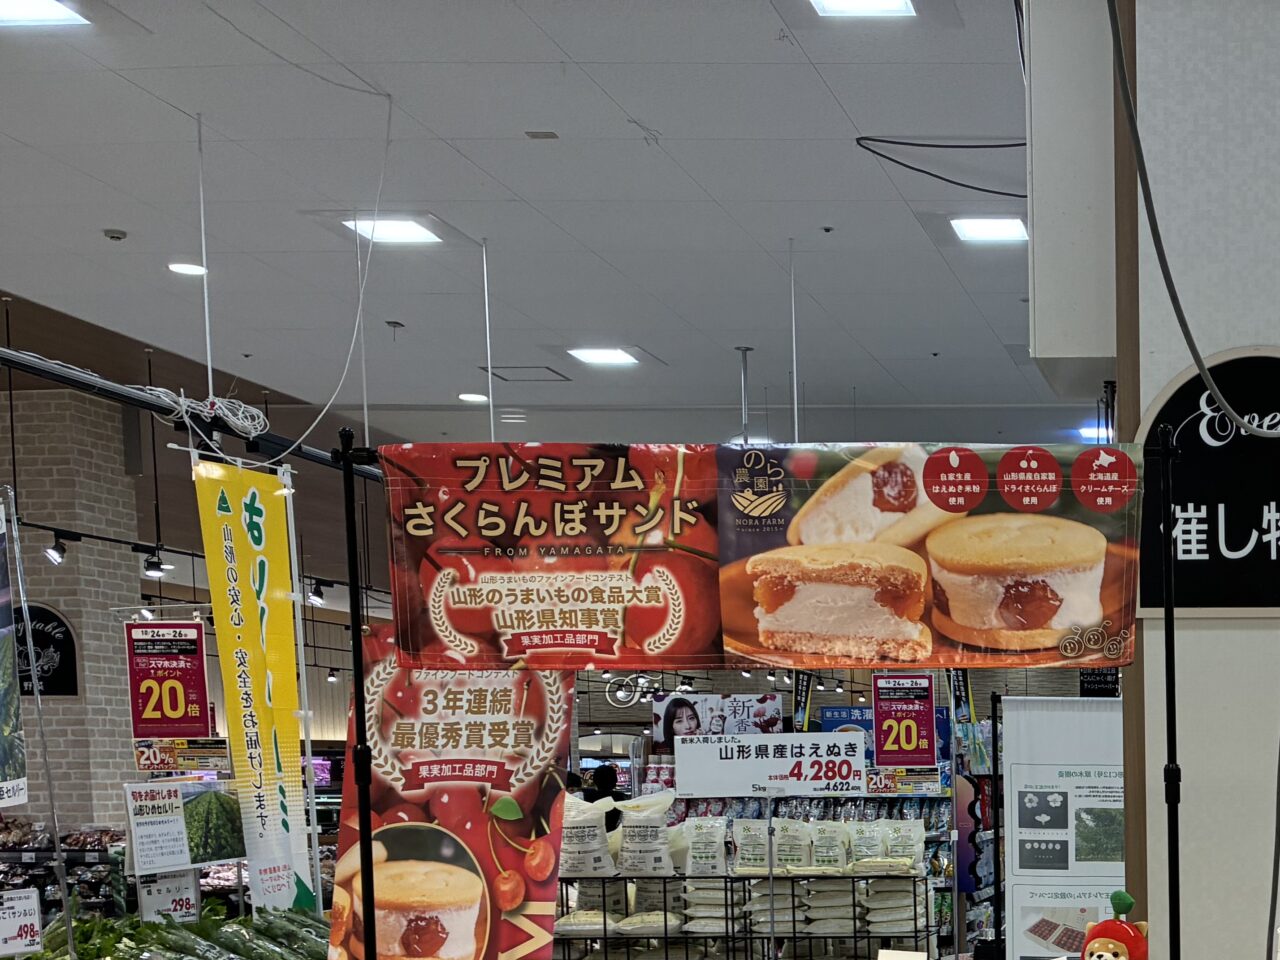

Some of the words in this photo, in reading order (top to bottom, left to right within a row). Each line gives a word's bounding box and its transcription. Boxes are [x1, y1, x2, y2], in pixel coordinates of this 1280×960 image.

[454, 456, 646, 492] プレミアム
[939, 472, 972, 481] 自家生産
[1003, 472, 1056, 481] 山形県産自家製
[1088, 472, 1119, 481] 北海道産
[932, 484, 980, 494] はえぬき米粉
[1003, 484, 1058, 494] ドライさくらんぼ
[1080, 484, 1129, 494] クリームチーズ
[948, 496, 965, 505] 使用
[1022, 496, 1038, 505] 使用
[1096, 496, 1112, 506] 使用
[403, 500, 700, 539] さくらんぼサンド
[762, 518, 785, 526] FARM
[484, 546, 528, 556] FROM
[539, 545, 626, 556] YAMAGATA
[480, 572, 632, 584] 山形うまいものファインフードコンテスト
[450, 584, 663, 606] 山形のうまいもの食品大賞
[493, 607, 623, 631] 山形県知事賞
[520, 633, 600, 647] 果実加工品部門
[139, 679, 186, 719] 20
[422, 687, 514, 717] 3年連続
[187, 703, 201, 717] 倍
[391, 720, 535, 750] 最優秀賞受賞
[681, 736, 742, 745] 新米入荷しました。
[882, 719, 918, 751] 20
[918, 738, 929, 749] 倍
[138, 747, 174, 765] 20%
[719, 742, 858, 760] 山形県産はえぬき
[418, 763, 499, 778] 果実加工品部門
[868, 774, 895, 789] 20%
[752, 784, 767, 793] 5kg
